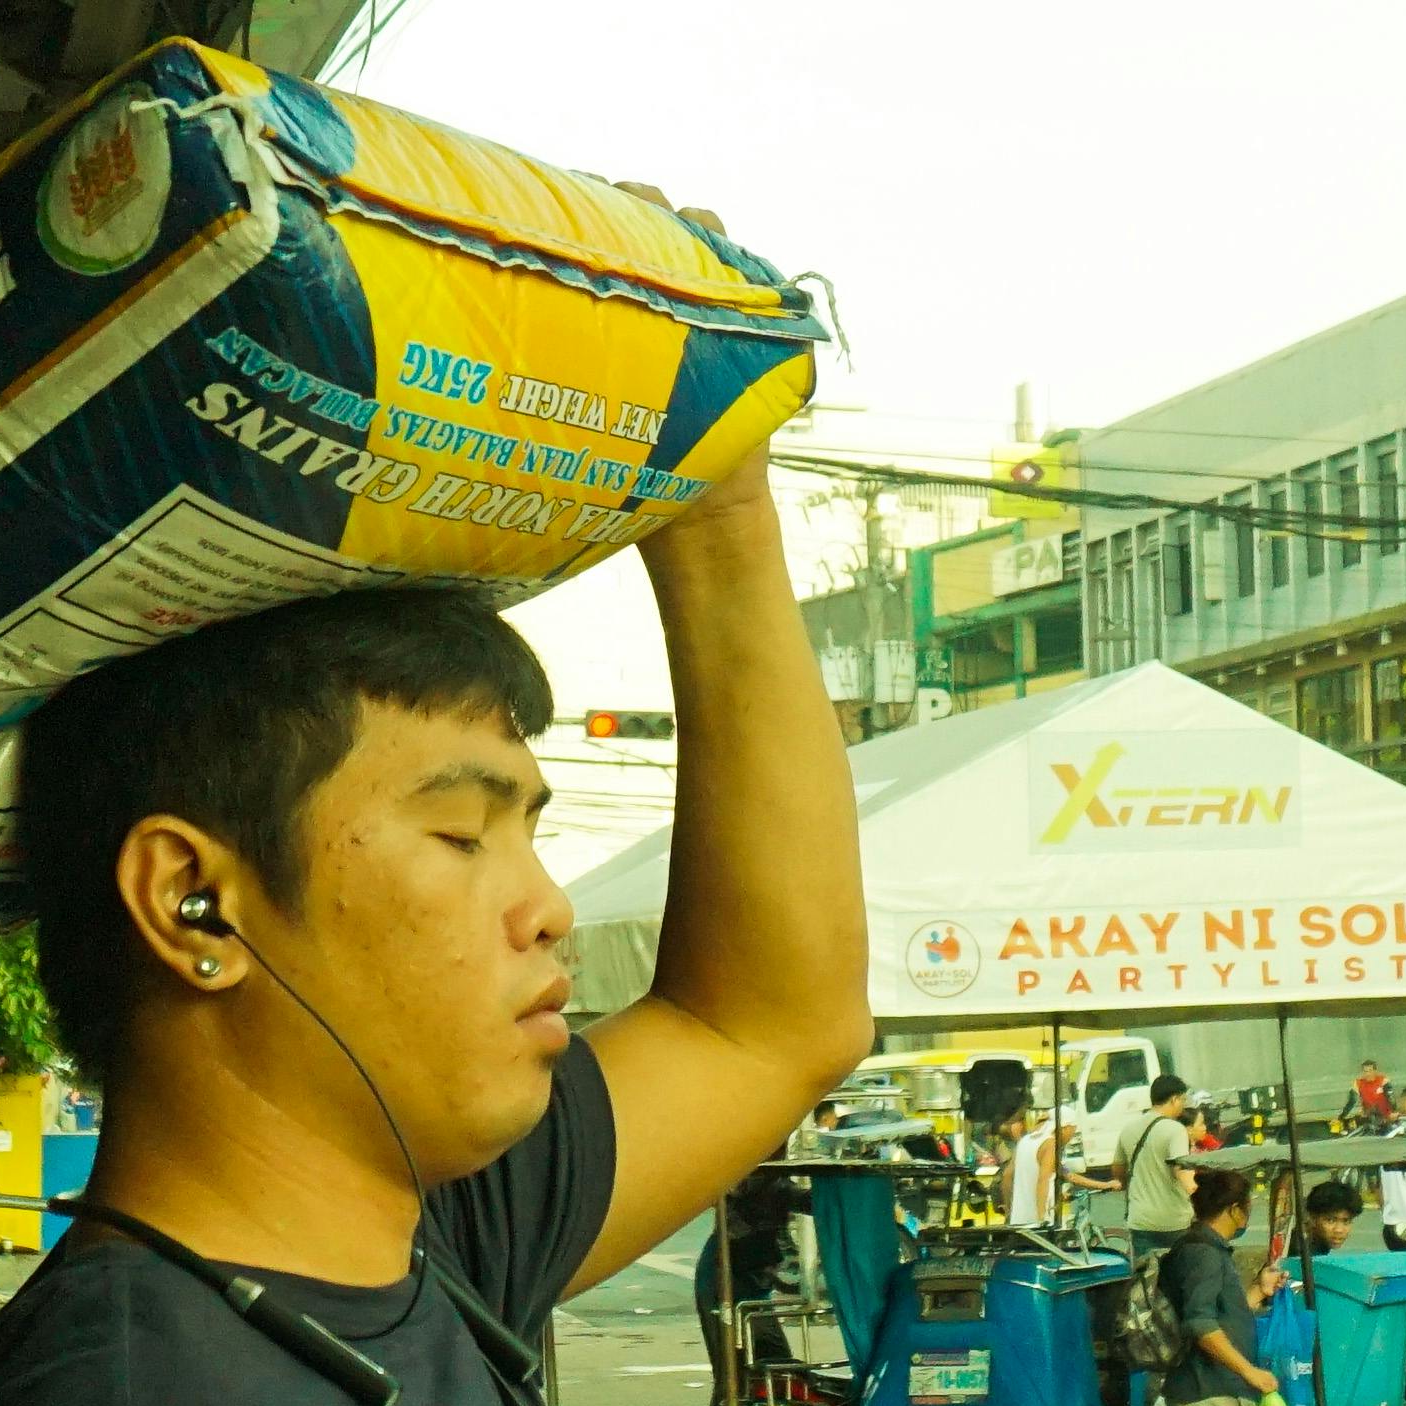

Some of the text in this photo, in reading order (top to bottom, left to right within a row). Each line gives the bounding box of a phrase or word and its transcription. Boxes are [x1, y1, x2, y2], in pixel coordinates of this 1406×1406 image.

[205, 327, 380, 431] BULACAN
[400, 342, 495, 403] 25KG
[187, 381, 422, 502] GRAINS
[614, 404, 668, 444] NET
[409, 472, 562, 540] NORTH
[998, 914, 1179, 960] AKAY
[1204, 908, 1277, 952] NI
